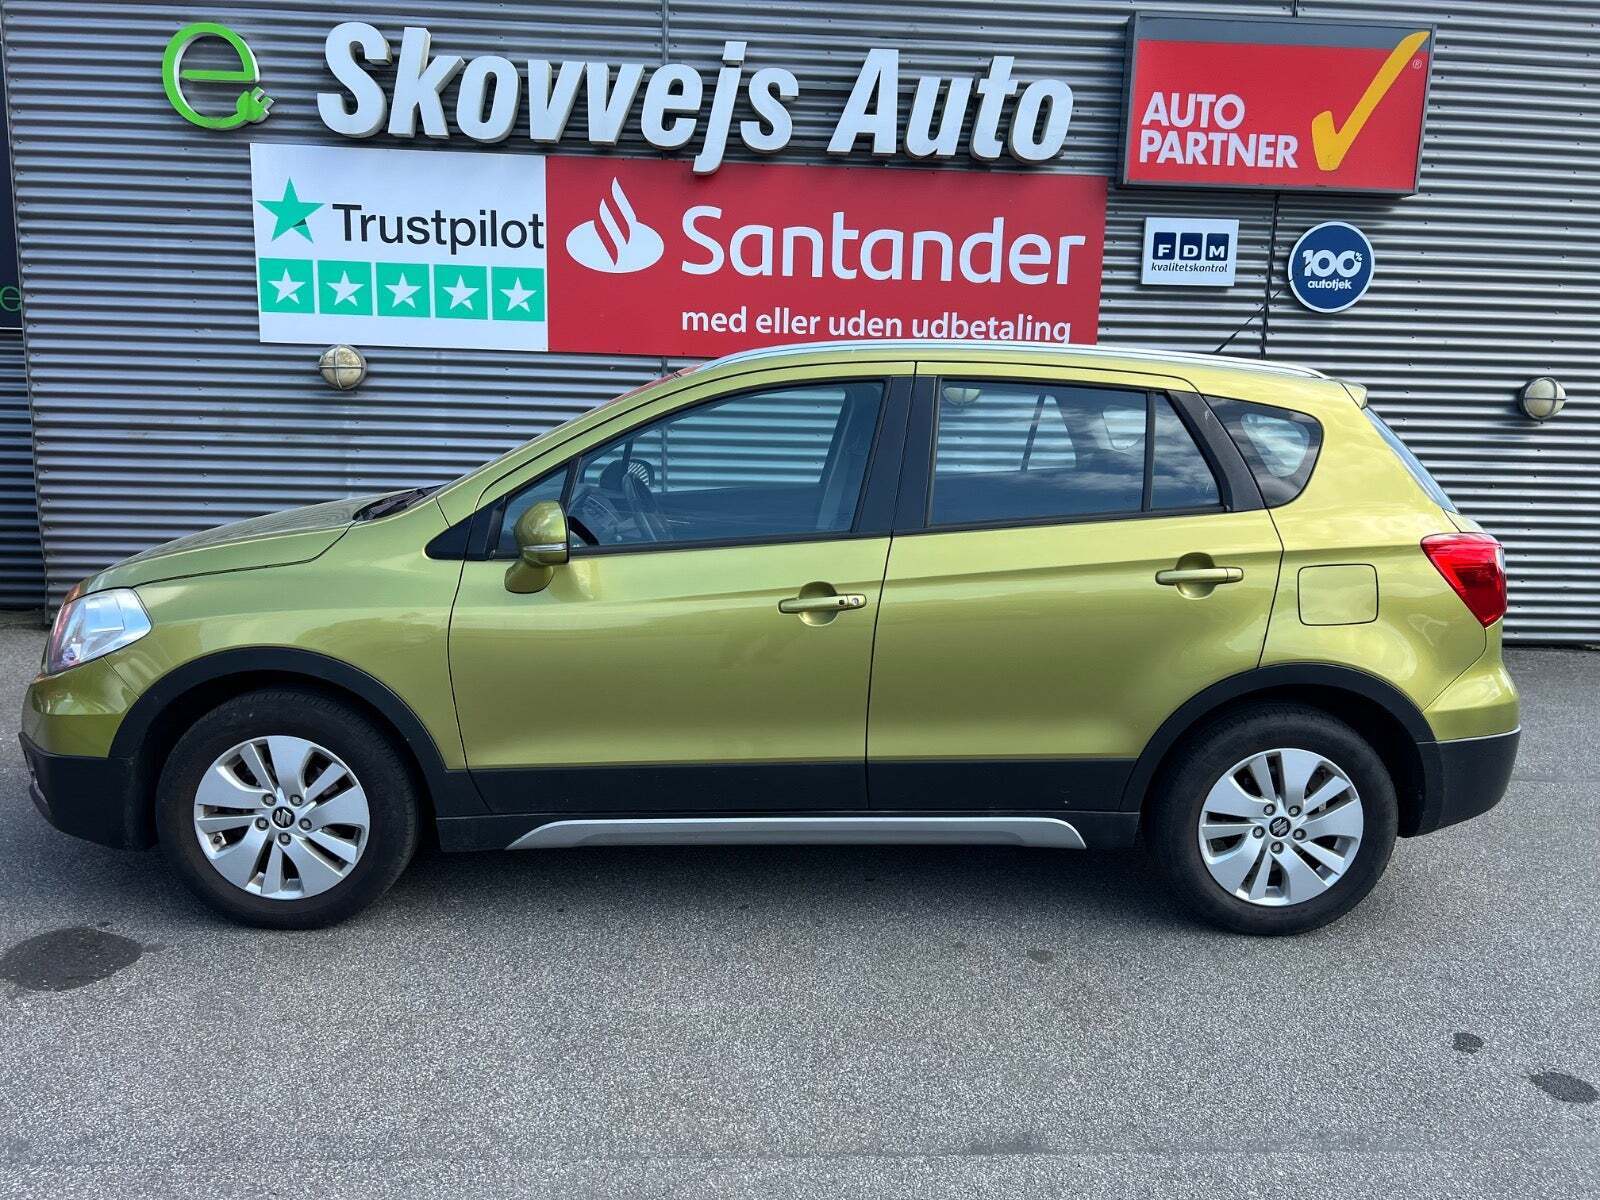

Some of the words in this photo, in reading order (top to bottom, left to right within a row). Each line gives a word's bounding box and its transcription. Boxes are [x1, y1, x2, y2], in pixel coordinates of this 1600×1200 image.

[316, 21, 799, 176] Skovvejs
[827, 48, 1074, 163] Auto
[1142, 91, 1246, 130] AUTO
[1139, 130, 1298, 169] PARTNER
[332, 203, 545, 255] Trustpilot
[680, 205, 1086, 286] Santander
[1151, 261, 1228, 274] kvalitetskontrol
[1307, 278, 1352, 291] autotjek
[681, 306, 747, 334] med
[755, 307, 820, 335] eller
[828, 311, 903, 338] uden
[911, 312, 1072, 345] udbetaling
